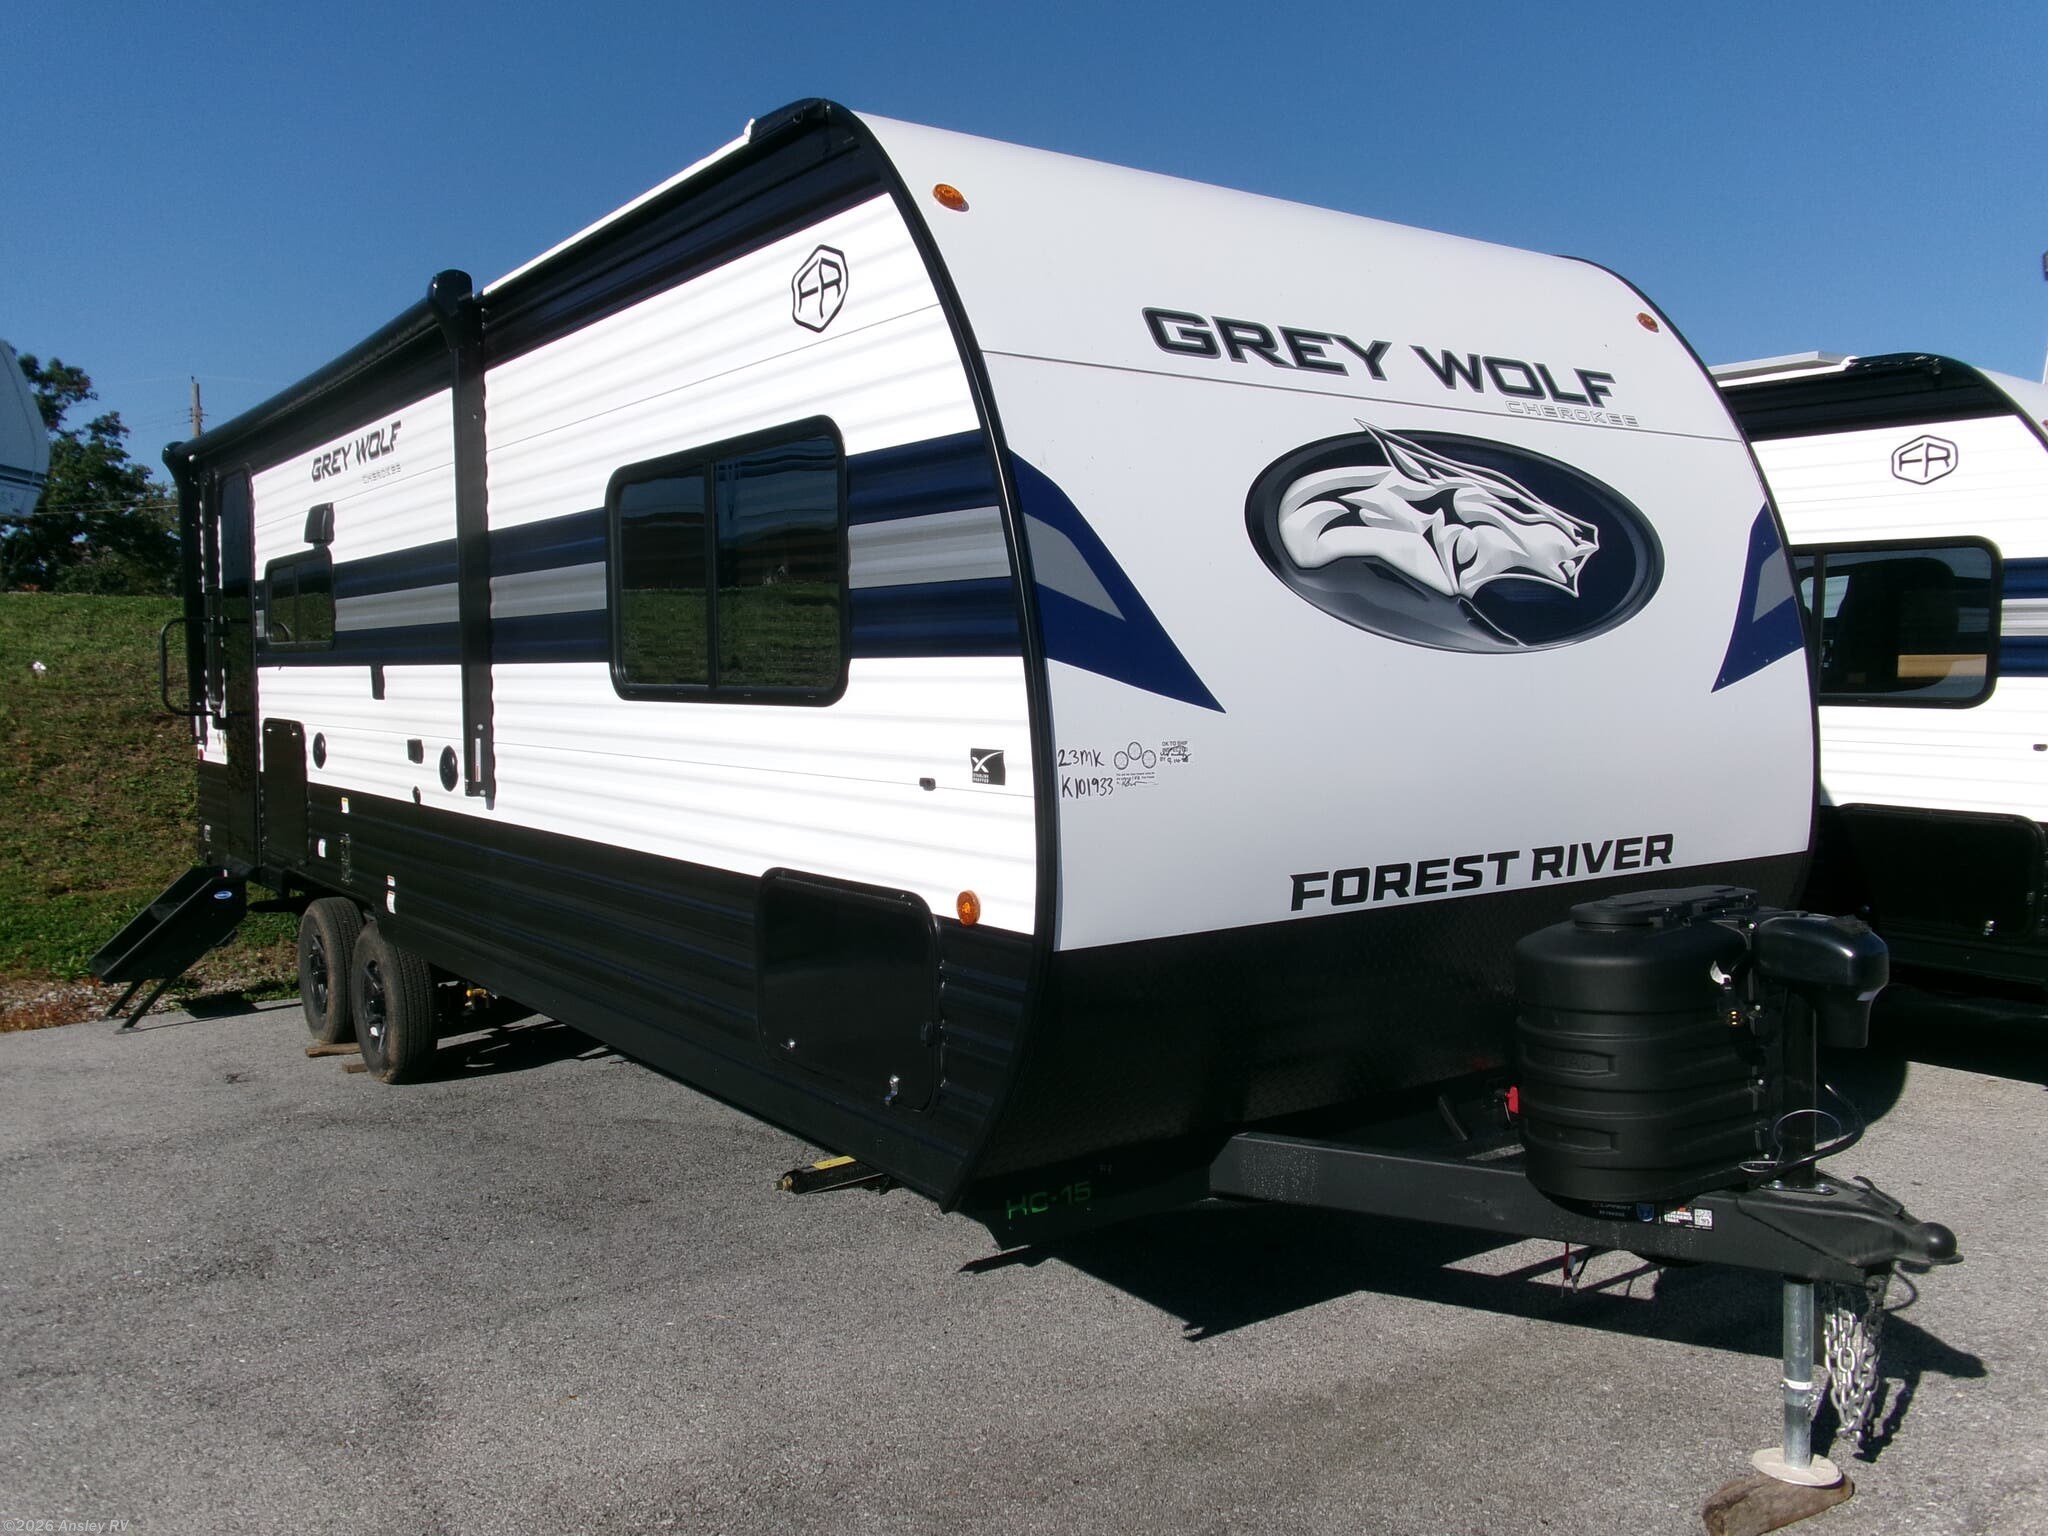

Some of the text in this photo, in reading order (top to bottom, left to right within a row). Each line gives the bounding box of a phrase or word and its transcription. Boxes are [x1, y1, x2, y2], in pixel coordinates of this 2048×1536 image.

[1142, 306, 1616, 409] GREY WOLF
[1505, 400, 1640, 427] CHEROKEE
[311, 419, 402, 483] GREY WOLF
[1289, 833, 1674, 912] FOREST RIVER
